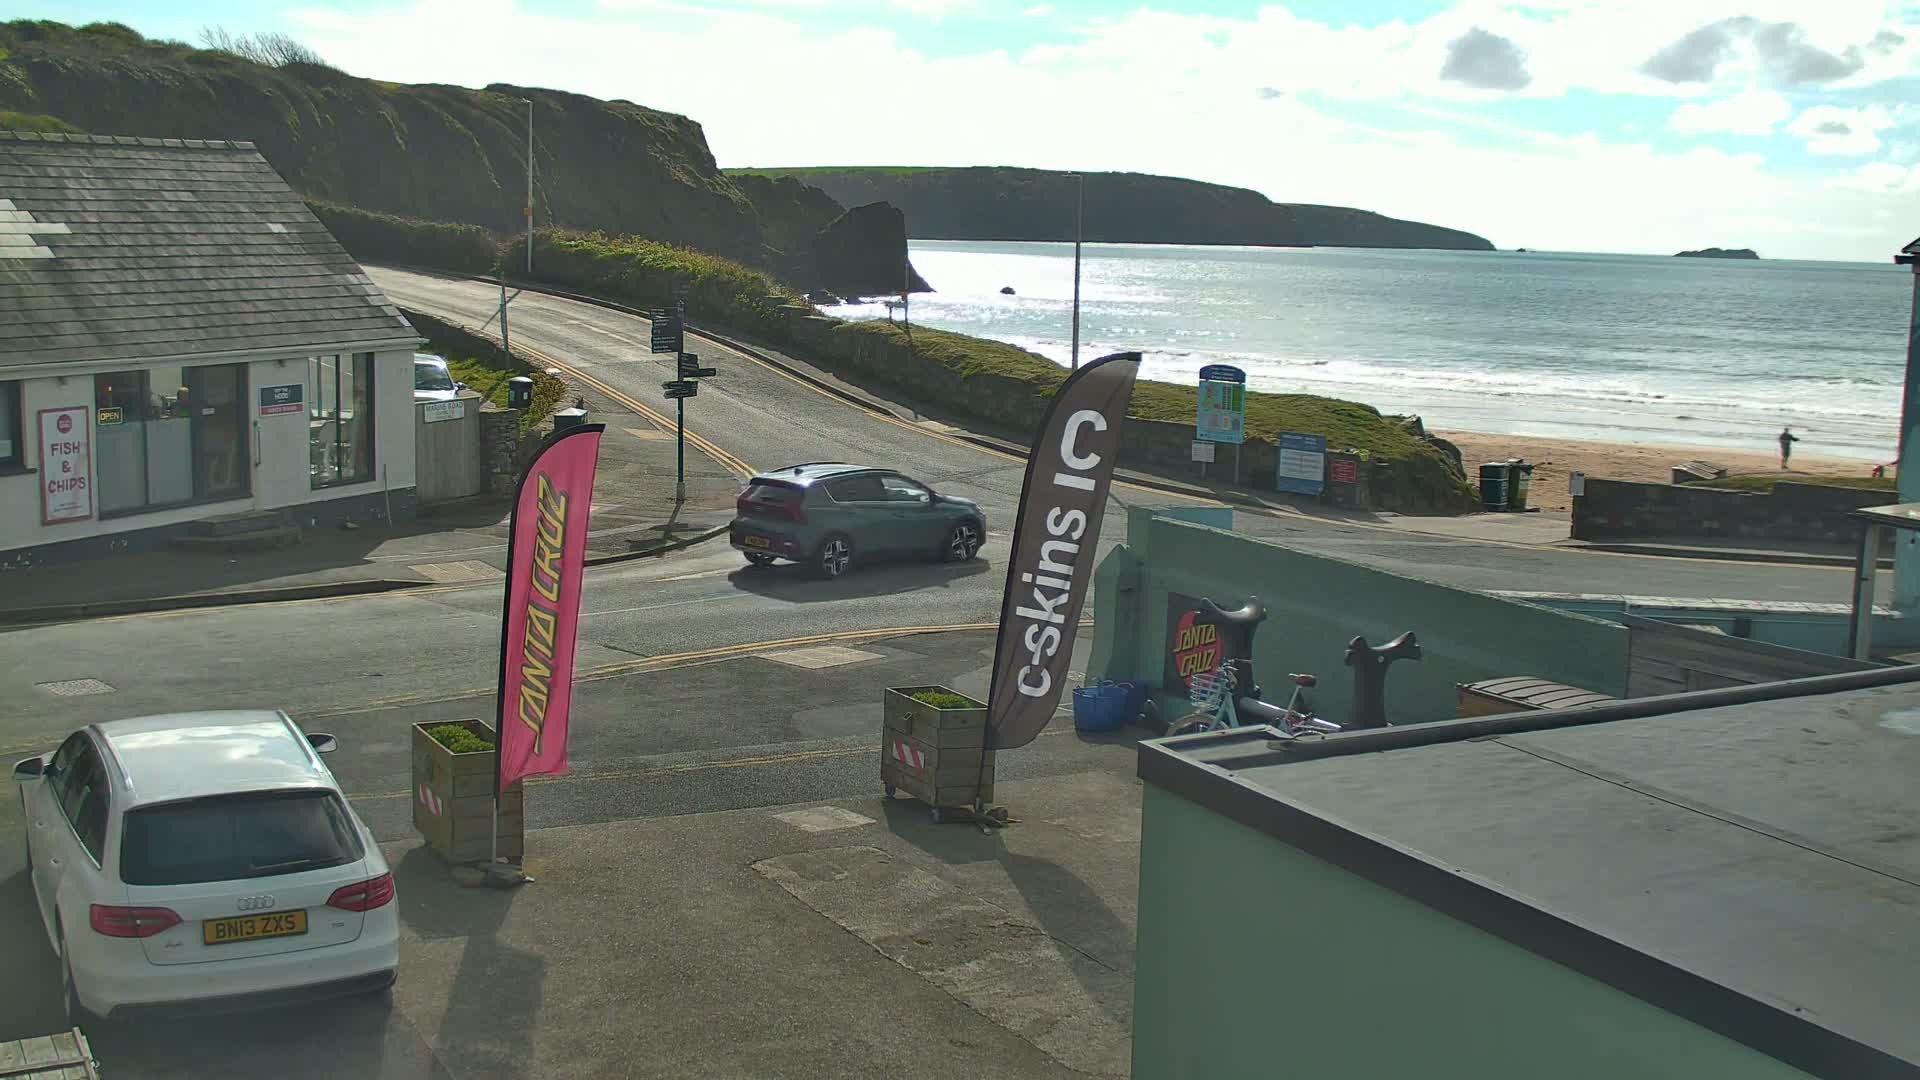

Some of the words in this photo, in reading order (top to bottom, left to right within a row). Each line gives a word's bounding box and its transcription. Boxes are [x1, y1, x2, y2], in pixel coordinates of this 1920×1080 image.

[100, 411, 120, 421] OPEN
[50, 440, 81, 457] FISH
[62, 460, 73, 474] &
[48, 476, 87, 494] CHIPS
[531, 472, 569, 603] CRUZ
[1016, 506, 1088, 698] c-skins
[1173, 624, 1217, 652] SANTA
[1180, 649, 1217, 677] CRUZ
[519, 601, 560, 756] SANTA
[215, 919, 256, 939] BN13
[261, 914, 296, 934] ZXS
